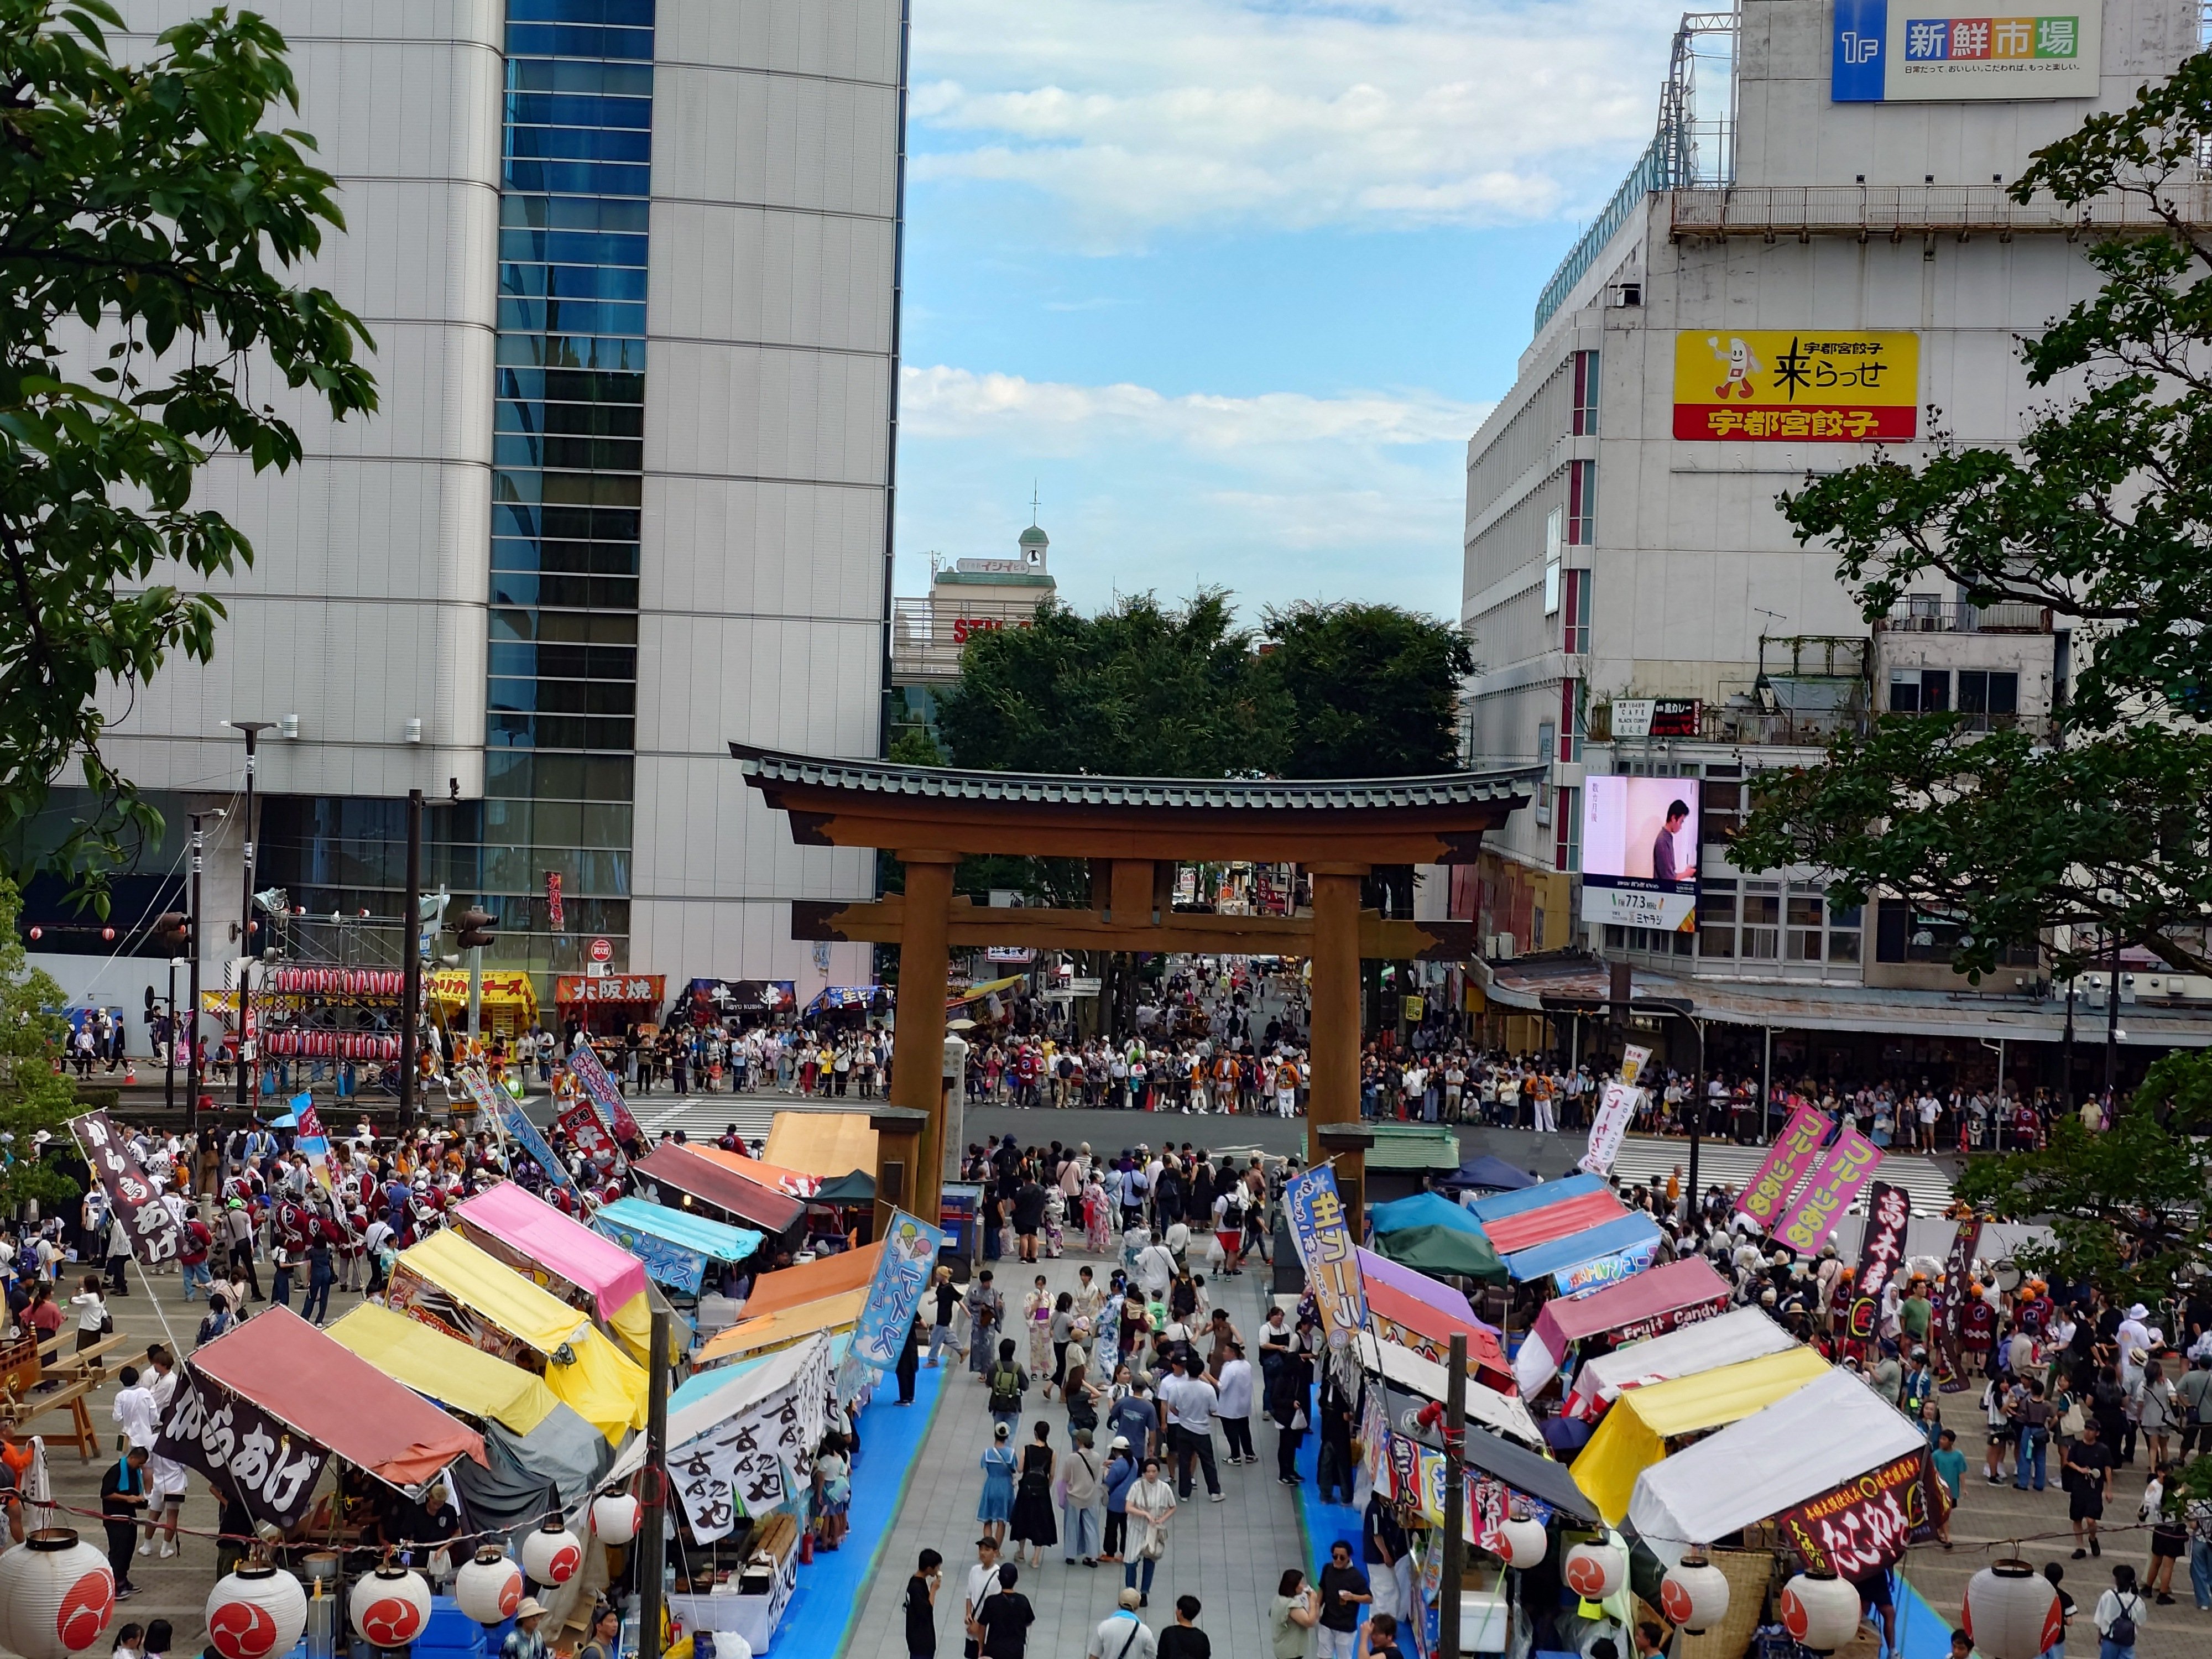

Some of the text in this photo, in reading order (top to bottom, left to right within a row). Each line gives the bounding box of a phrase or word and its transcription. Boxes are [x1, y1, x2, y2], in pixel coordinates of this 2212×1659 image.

[1842, 32, 1878, 64] 1F
[1910, 20, 2075, 58] 新鮮市場
[1804, 343, 1884, 354] 宇都宮餃子
[1773, 336, 1887, 402] 来らっせ
[1708, 410, 1879, 437] 宇都宮餃子
[1637, 913, 1663, 925] ミヤラジ
[572, 978, 652, 1001] 大阪焼
[1746, 1112, 1822, 1216] フルーツあめ
[1786, 1137, 1874, 1249] フルーツあめ
[1624, 1317, 1665, 1340] Fruit
[1673, 1303, 1719, 1324] Candy
[165, 1384, 320, 1513] からあげ
